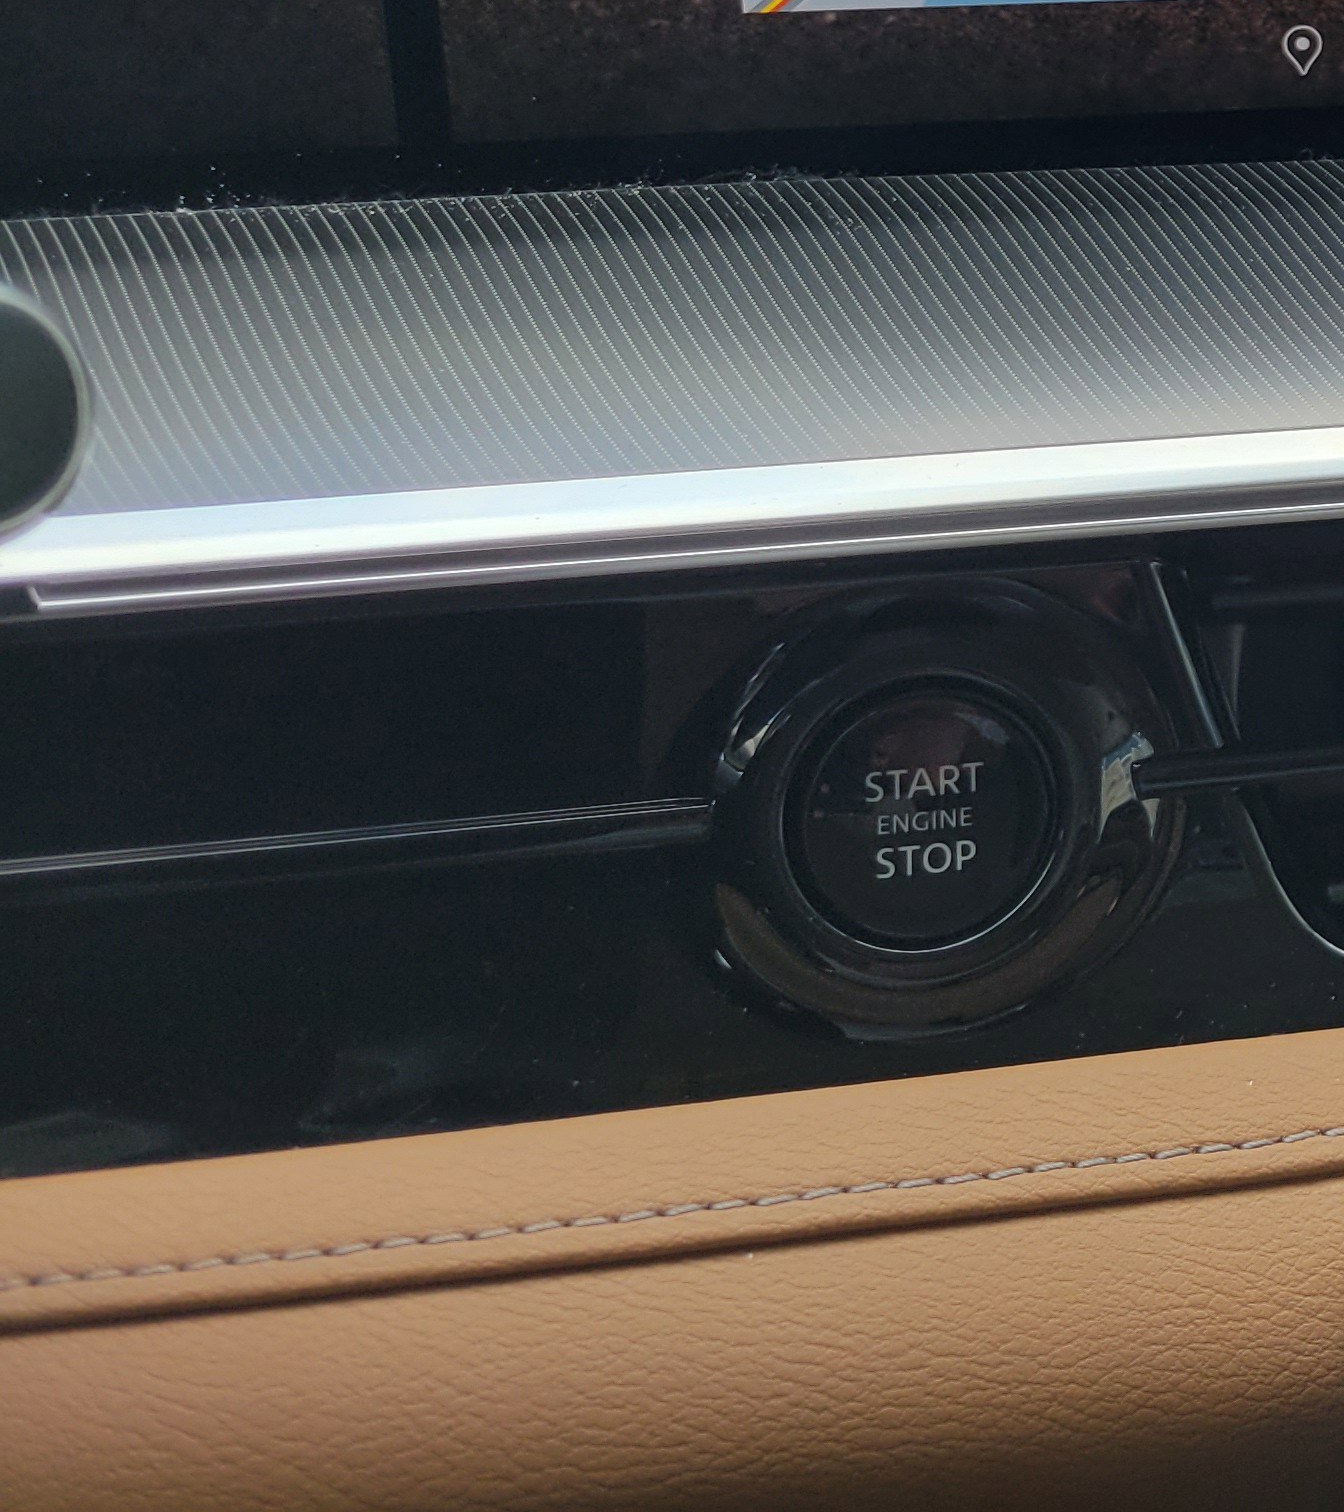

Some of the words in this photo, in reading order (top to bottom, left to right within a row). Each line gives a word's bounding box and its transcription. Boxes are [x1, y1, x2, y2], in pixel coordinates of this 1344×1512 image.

[864, 761, 985, 804] START
[876, 807, 974, 836] ENGINE
[874, 839, 977, 879] STOP
